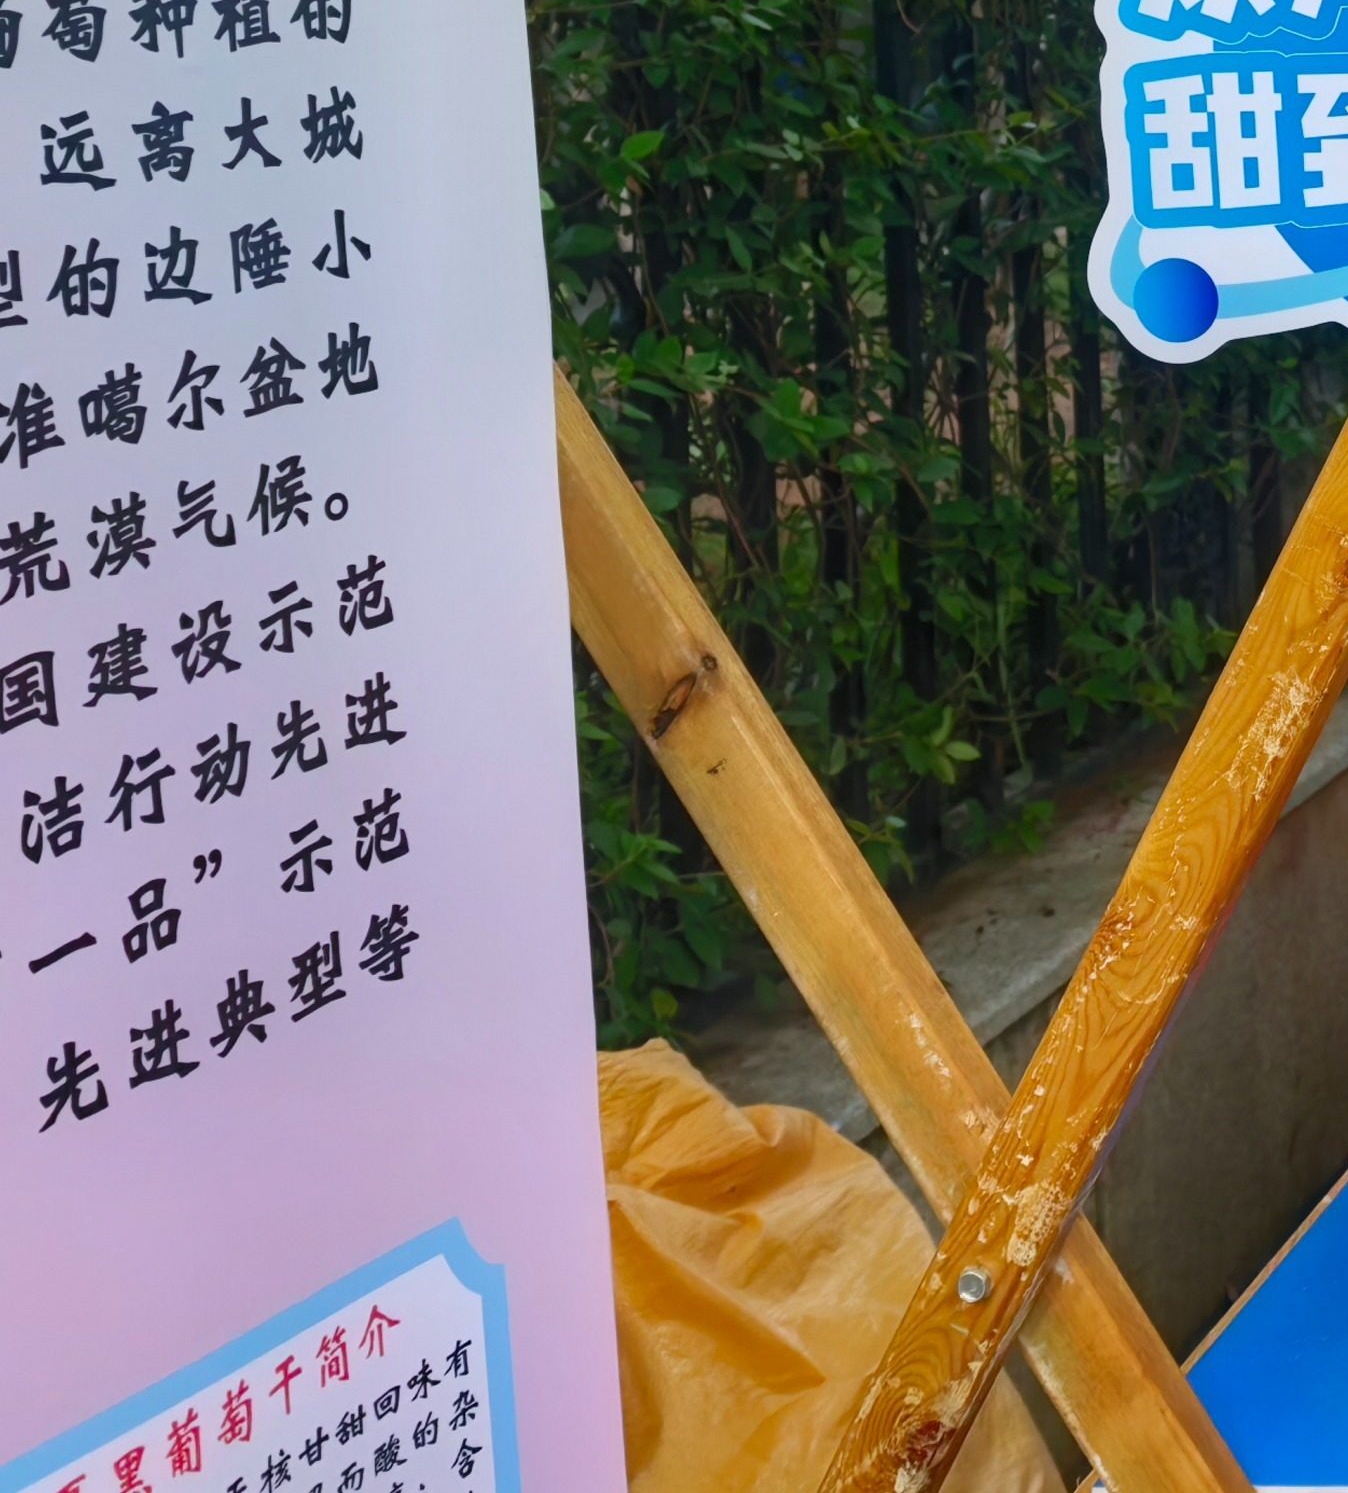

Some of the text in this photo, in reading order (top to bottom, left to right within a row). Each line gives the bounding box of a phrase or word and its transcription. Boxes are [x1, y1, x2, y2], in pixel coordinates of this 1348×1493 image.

[40, 85, 364, 191] 远离大城
[0, 322, 379, 469] 准噶尔盆地
[0, 454, 349, 606] 荒漠气候。
[0, 554, 395, 735] 国建设示范
[21, 671, 408, 865] 洁行动先进
[38, 903, 420, 1134] 先进典型等
[56, 1304, 401, 1493] 黑葡萄干简介
[307, 1389, 479, 1493] 而酸的杂
